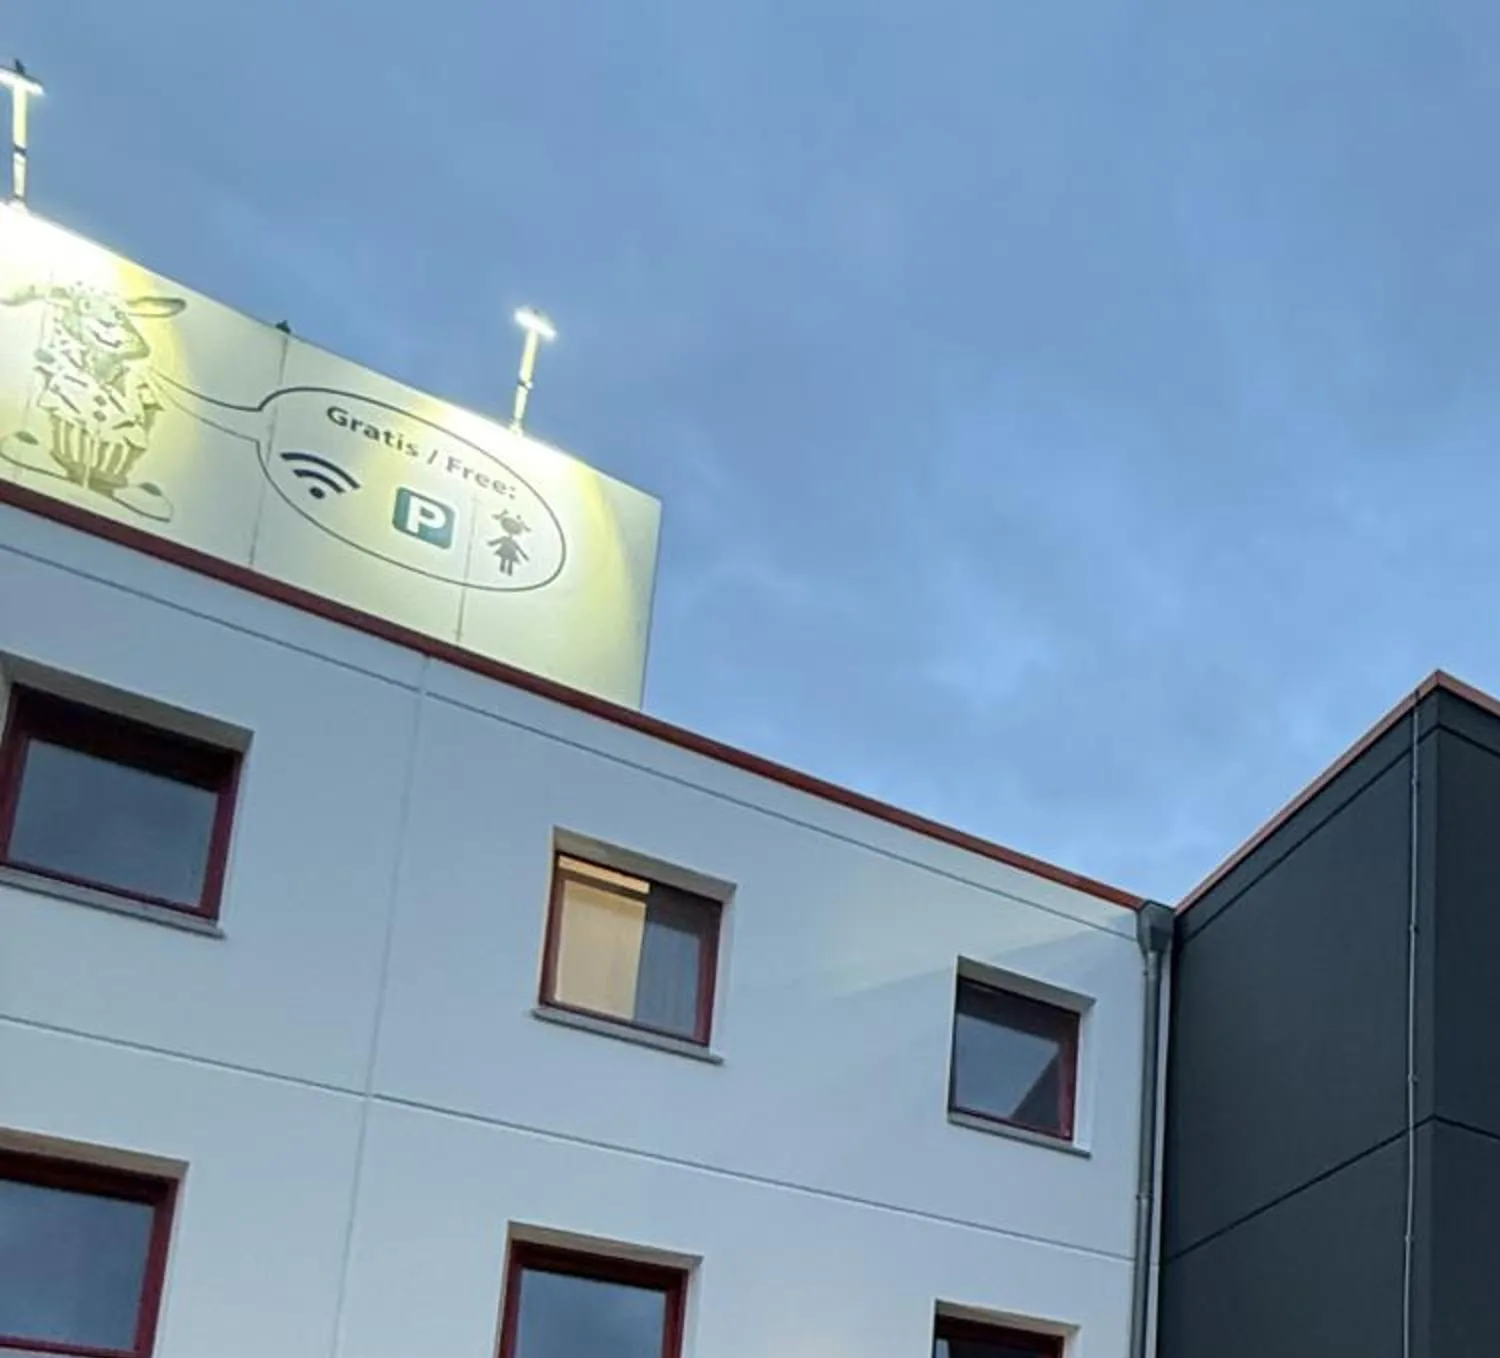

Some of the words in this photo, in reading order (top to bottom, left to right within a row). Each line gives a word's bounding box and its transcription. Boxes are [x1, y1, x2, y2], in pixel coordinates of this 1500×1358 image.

[326, 405, 419, 457] Gratis
[445, 456, 517, 500] Free:
[405, 495, 447, 535] P
